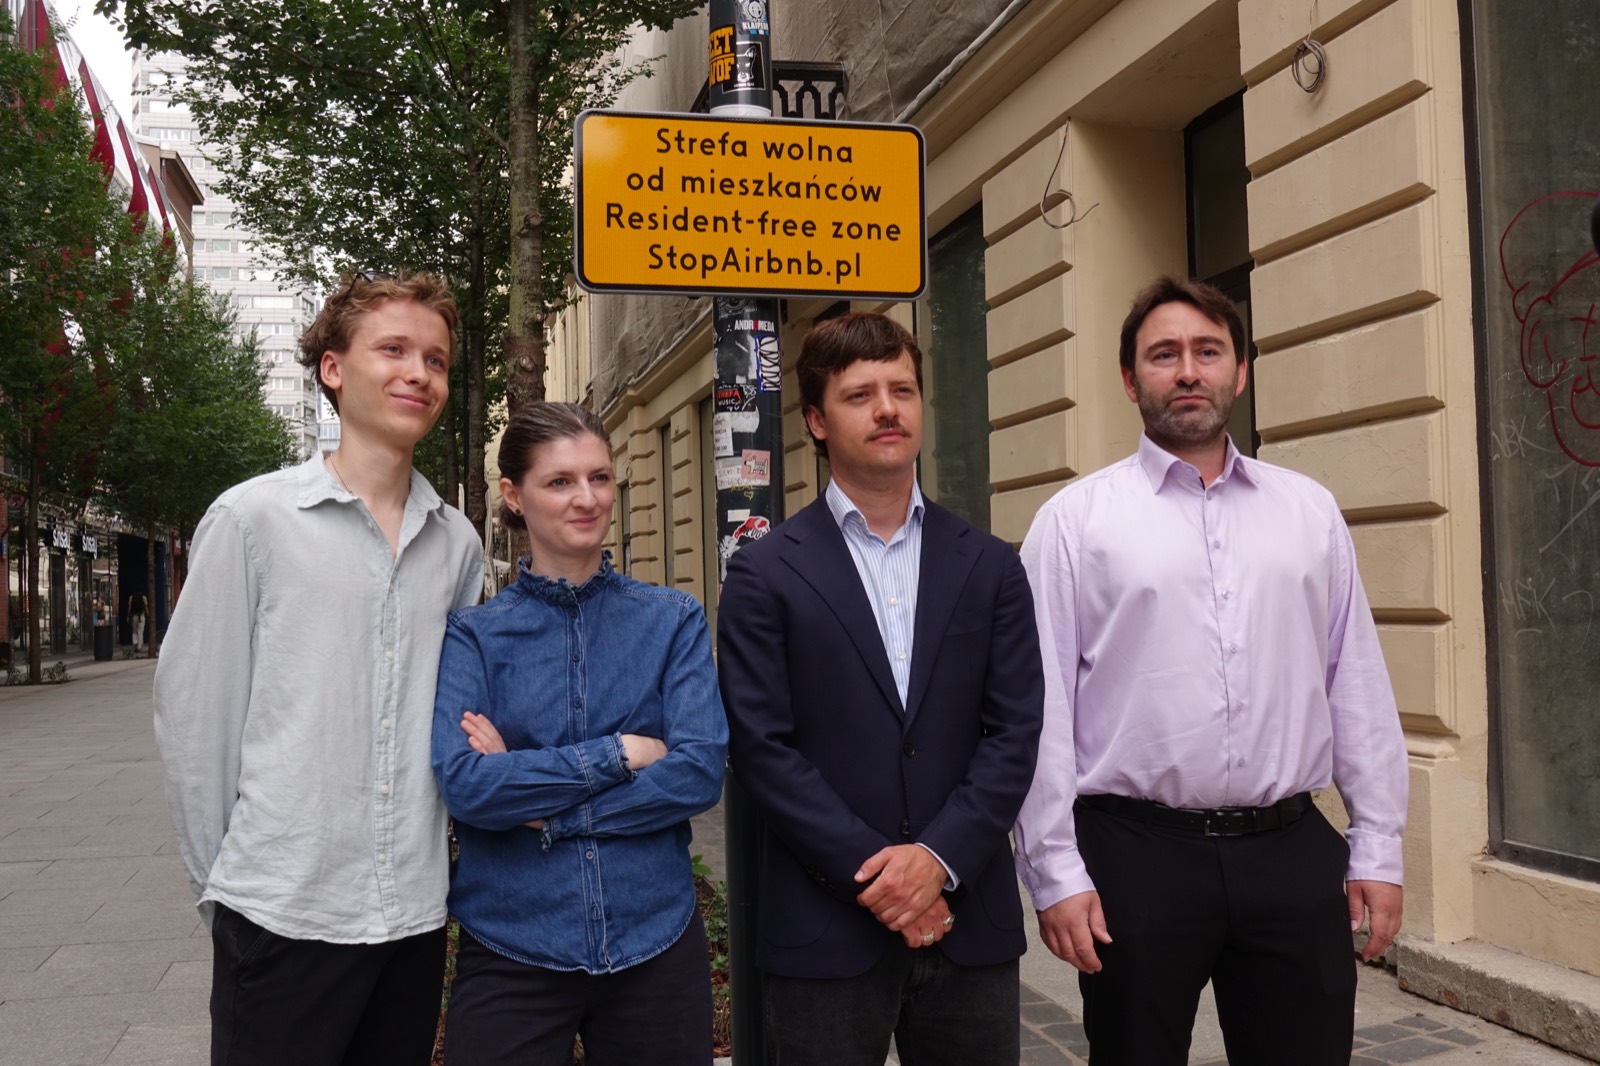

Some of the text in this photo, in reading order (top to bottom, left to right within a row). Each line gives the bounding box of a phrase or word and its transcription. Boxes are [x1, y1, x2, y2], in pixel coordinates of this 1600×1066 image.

[656, 127, 853, 164] Strefa wolna
[626, 166, 882, 203] od mieszkańców
[606, 202, 901, 242] Resident-free zone
[648, 243, 861, 285] StopAirbnb.pl
[734, 319, 775, 333] ANDROMEDA
